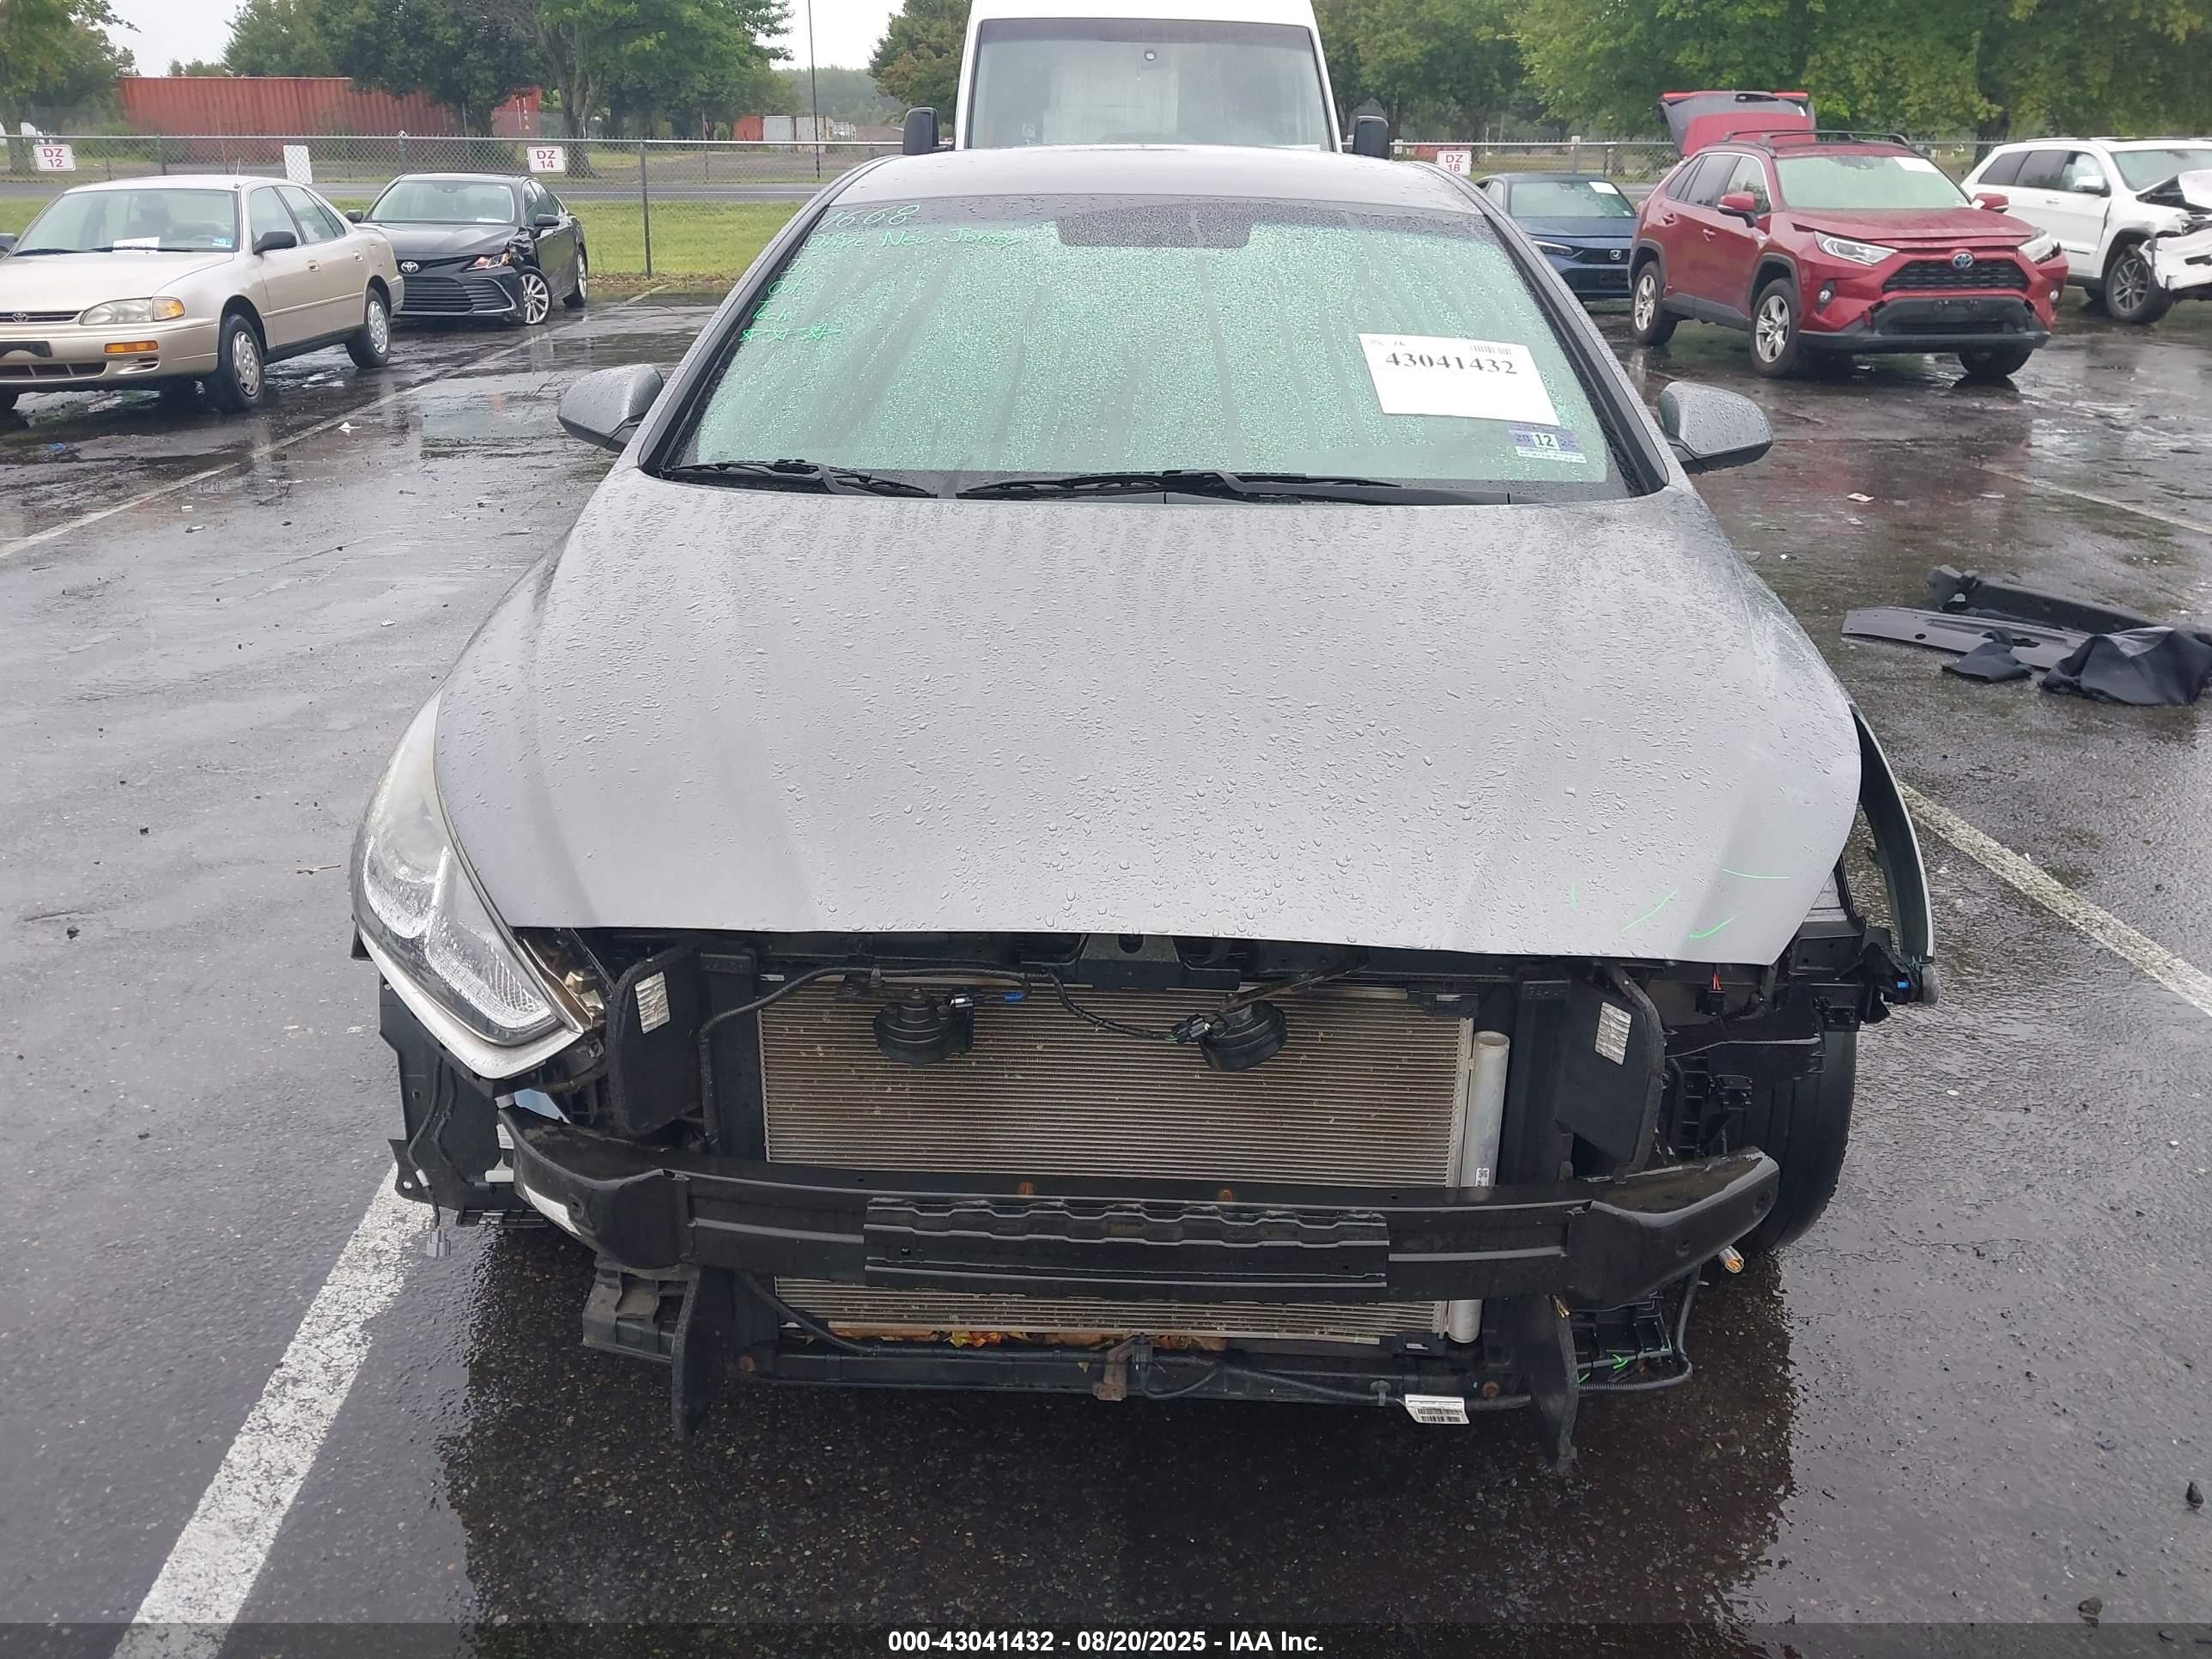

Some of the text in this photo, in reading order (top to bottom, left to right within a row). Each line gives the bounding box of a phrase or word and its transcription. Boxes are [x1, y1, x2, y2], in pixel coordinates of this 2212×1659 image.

[43, 149, 64, 157] DZ
[537, 150, 556, 159] DZ
[48, 159, 64, 167] 12
[1446, 155, 1463, 163] DZ
[539, 161, 554, 169] 14
[880, 231, 933, 248] New
[1386, 353, 1517, 374] 43041432
[1535, 433, 1554, 447] 12
